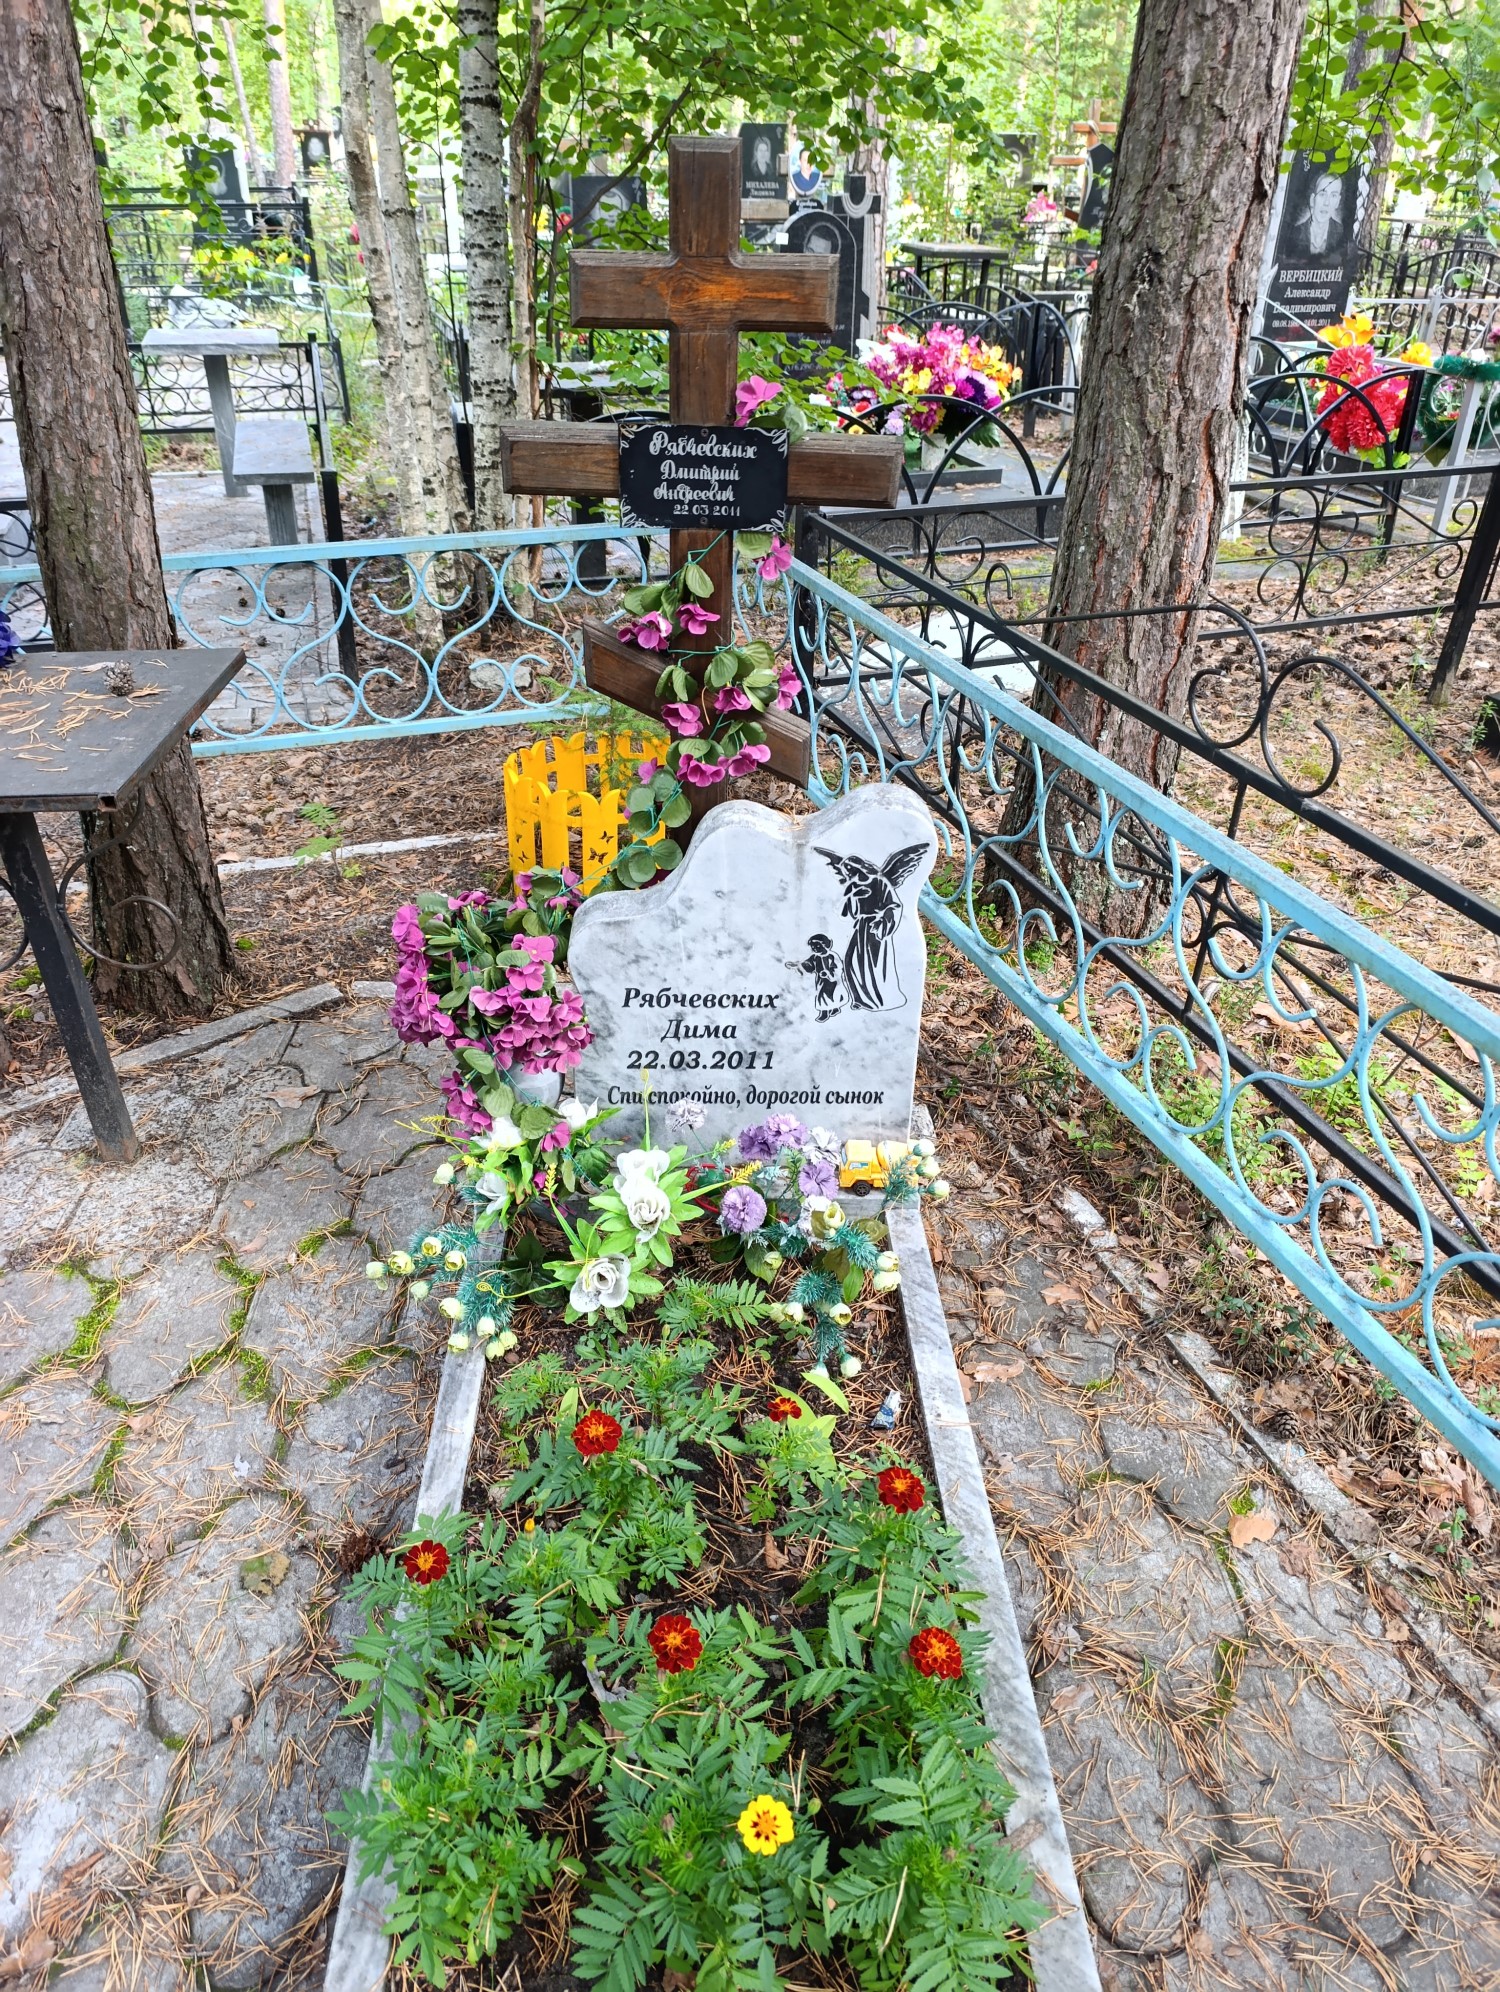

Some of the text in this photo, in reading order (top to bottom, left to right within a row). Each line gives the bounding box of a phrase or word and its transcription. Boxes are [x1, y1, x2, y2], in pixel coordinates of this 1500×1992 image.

[1279, 266, 1344, 284] ВЕРБИЦКИЙ
[1284, 286, 1332, 300] Александр
[649, 431, 758, 459] Рябчевских
[660, 459, 741, 484] Дмитрий
[653, 481, 735, 503] Андреевич
[622, 987, 780, 1009] Рябчевских
[660, 1019, 738, 1042] Дима
[626, 1050, 774, 1070] 22.03.2011
[607, 1085, 644, 1106] Спи
[746, 1084, 822, 1110] дорогой
[824, 1089, 884, 1106] сынок
